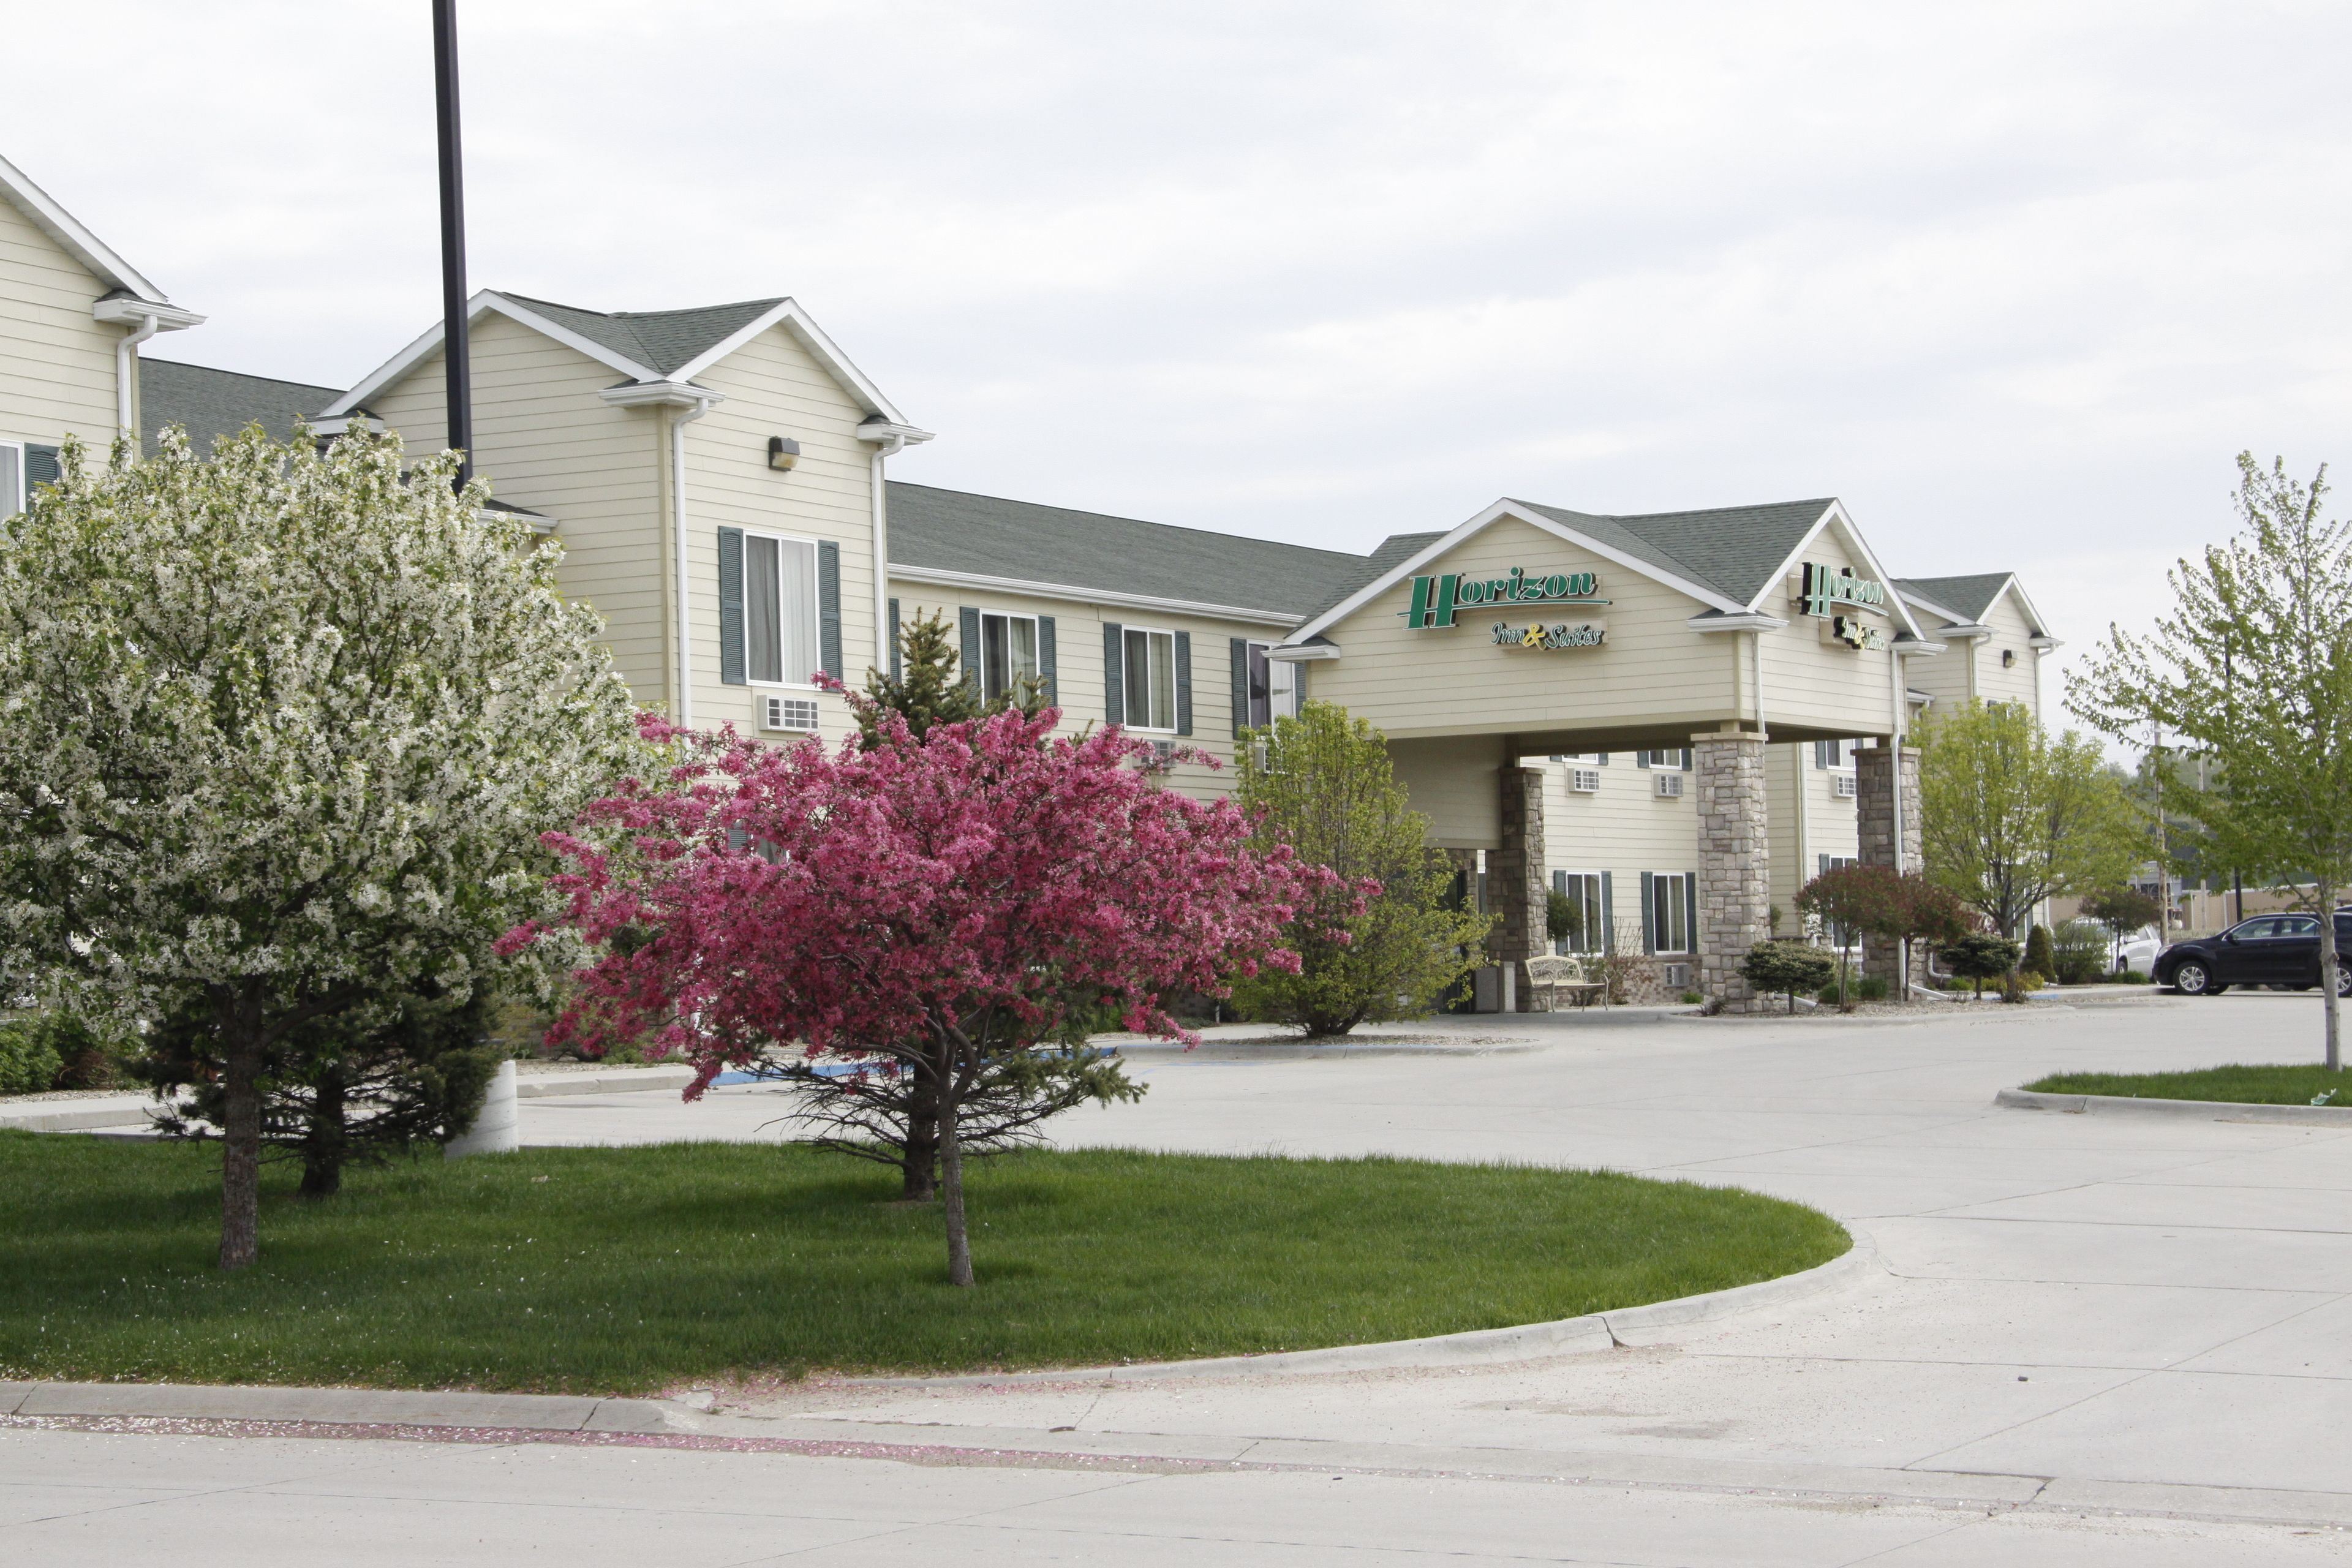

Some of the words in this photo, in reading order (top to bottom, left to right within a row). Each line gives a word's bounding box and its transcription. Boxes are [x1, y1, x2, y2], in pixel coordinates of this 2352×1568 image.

[1403, 566, 1597, 630] Horizon
[1807, 563, 1883, 618] Horizon
[1490, 622, 1525, 645] Inn
[1522, 624, 1546, 650] &
[1544, 624, 1602, 648] Suites
